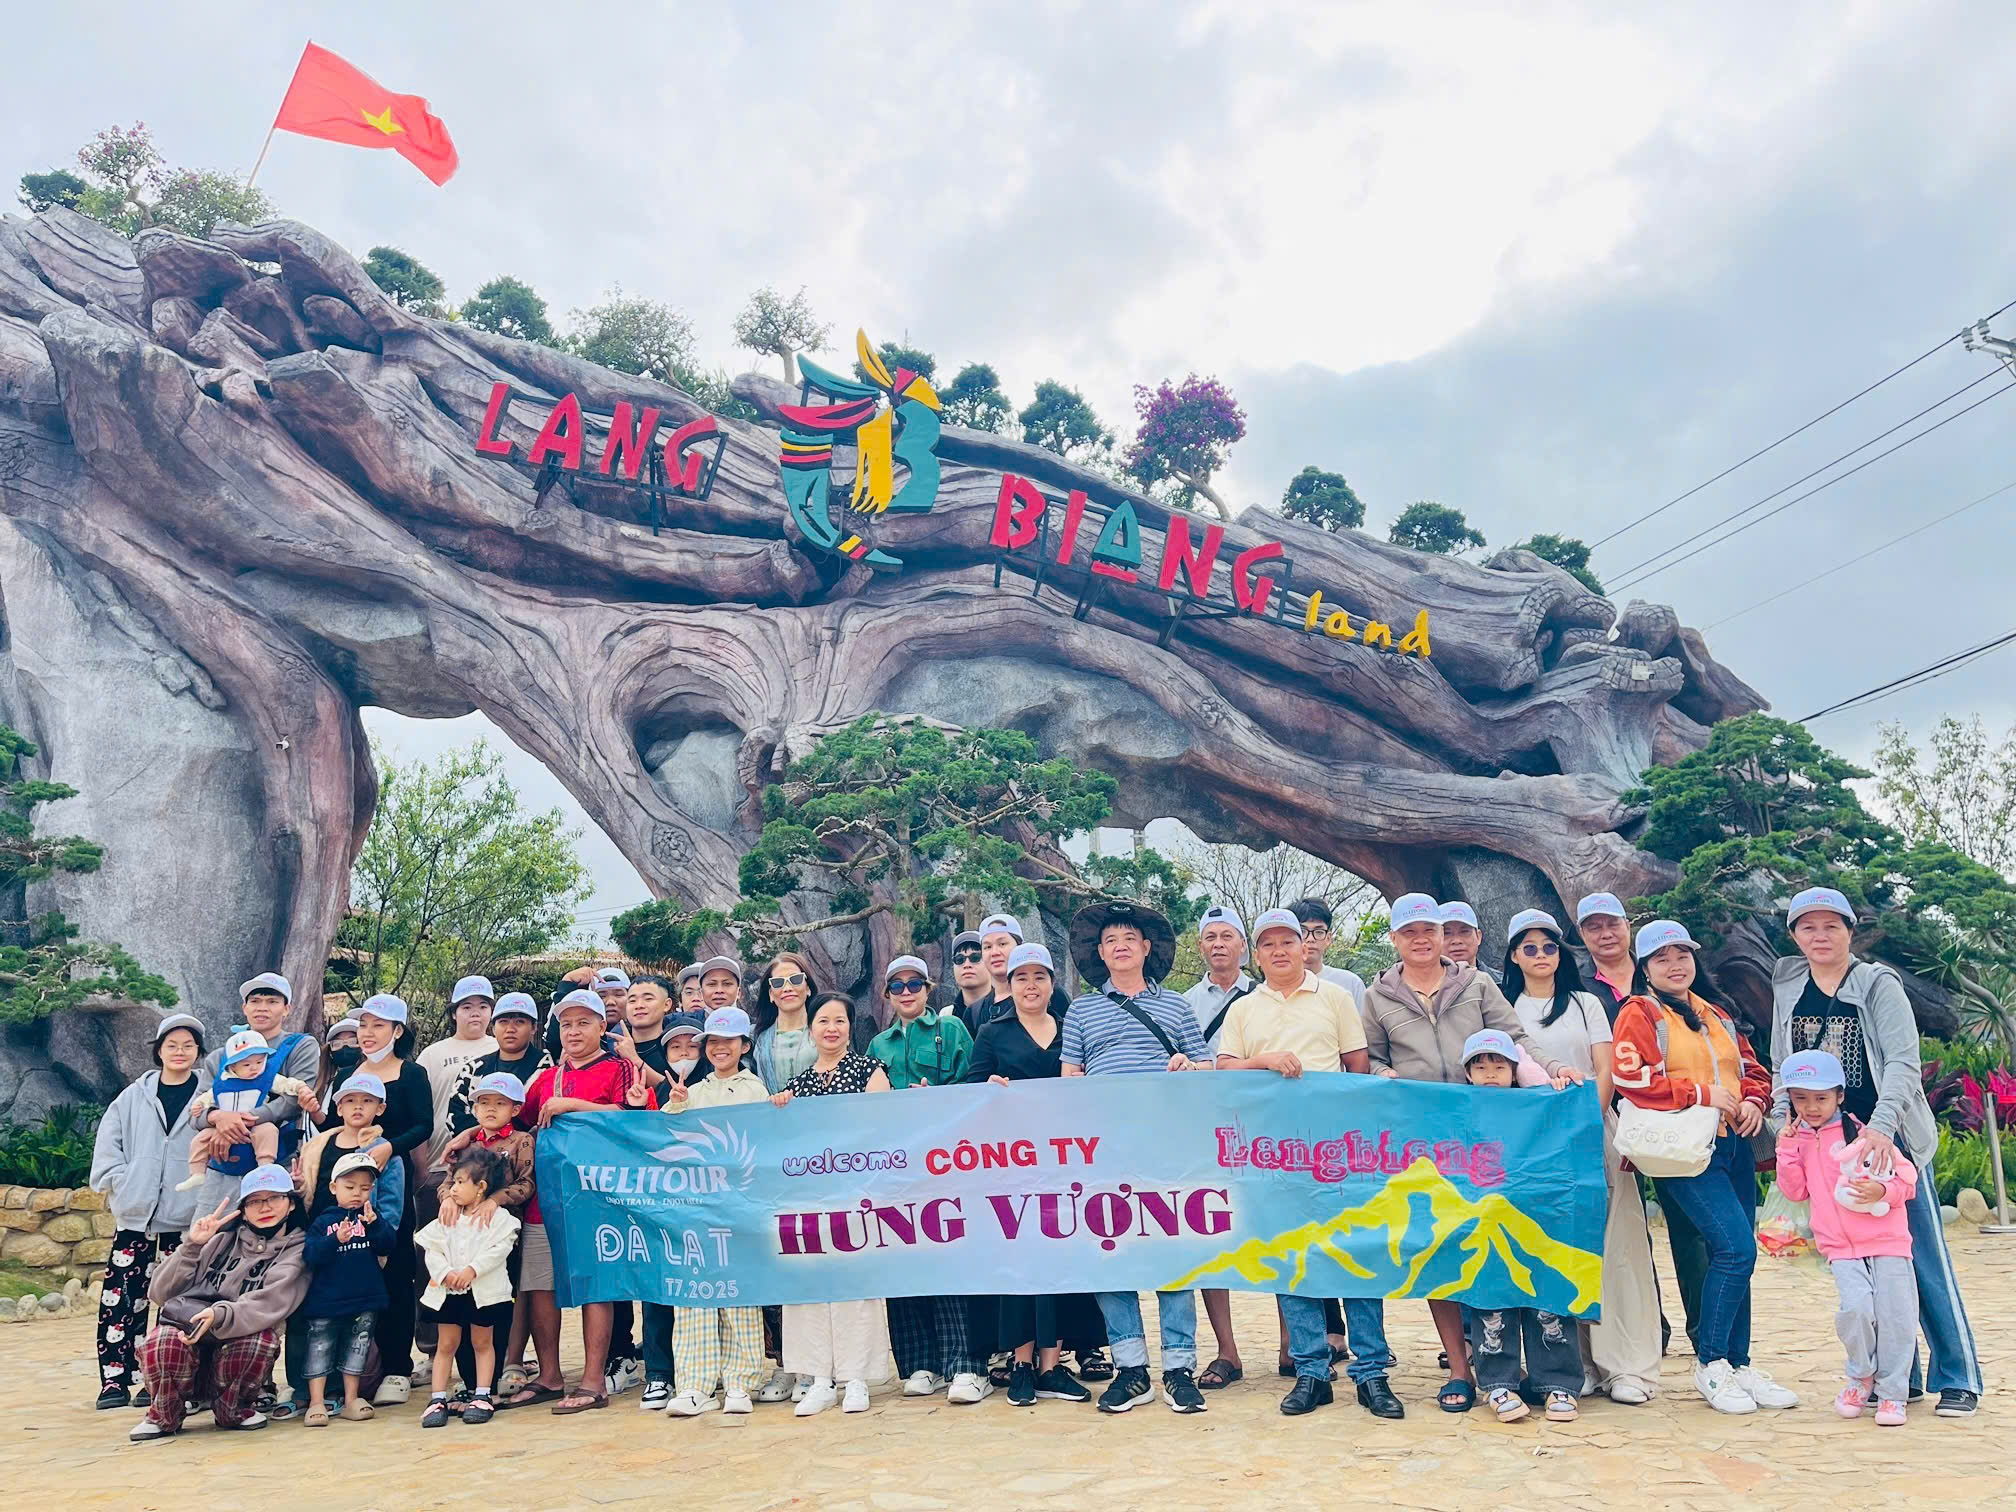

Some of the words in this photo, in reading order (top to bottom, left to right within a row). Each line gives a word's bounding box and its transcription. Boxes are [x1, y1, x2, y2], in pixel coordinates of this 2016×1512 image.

[475, 381, 719, 495] LANG
[990, 473, 1285, 615] BIANG
[1304, 590, 1432, 659] land
[444, 1056, 459, 1067] JIE
[1616, 1041, 1640, 1072] S
[783, 1147, 907, 1177] welcome
[925, 1138, 1037, 1176] CÔNG
[1050, 1137, 1100, 1165] TY
[1215, 1127, 1505, 1187] Langbiang
[577, 1165, 731, 1194] HELITOUR
[626, 1198, 656, 1206] TRAVEL
[663, 1197, 686, 1207] ENJOY
[774, 1199, 966, 1256] HƯNG
[986, 1182, 1233, 1252] VƯỢNG
[596, 1215, 650, 1263] ĐÀ
[660, 1228, 732, 1274] LẠT
[665, 1278, 739, 1300] T7.2025
